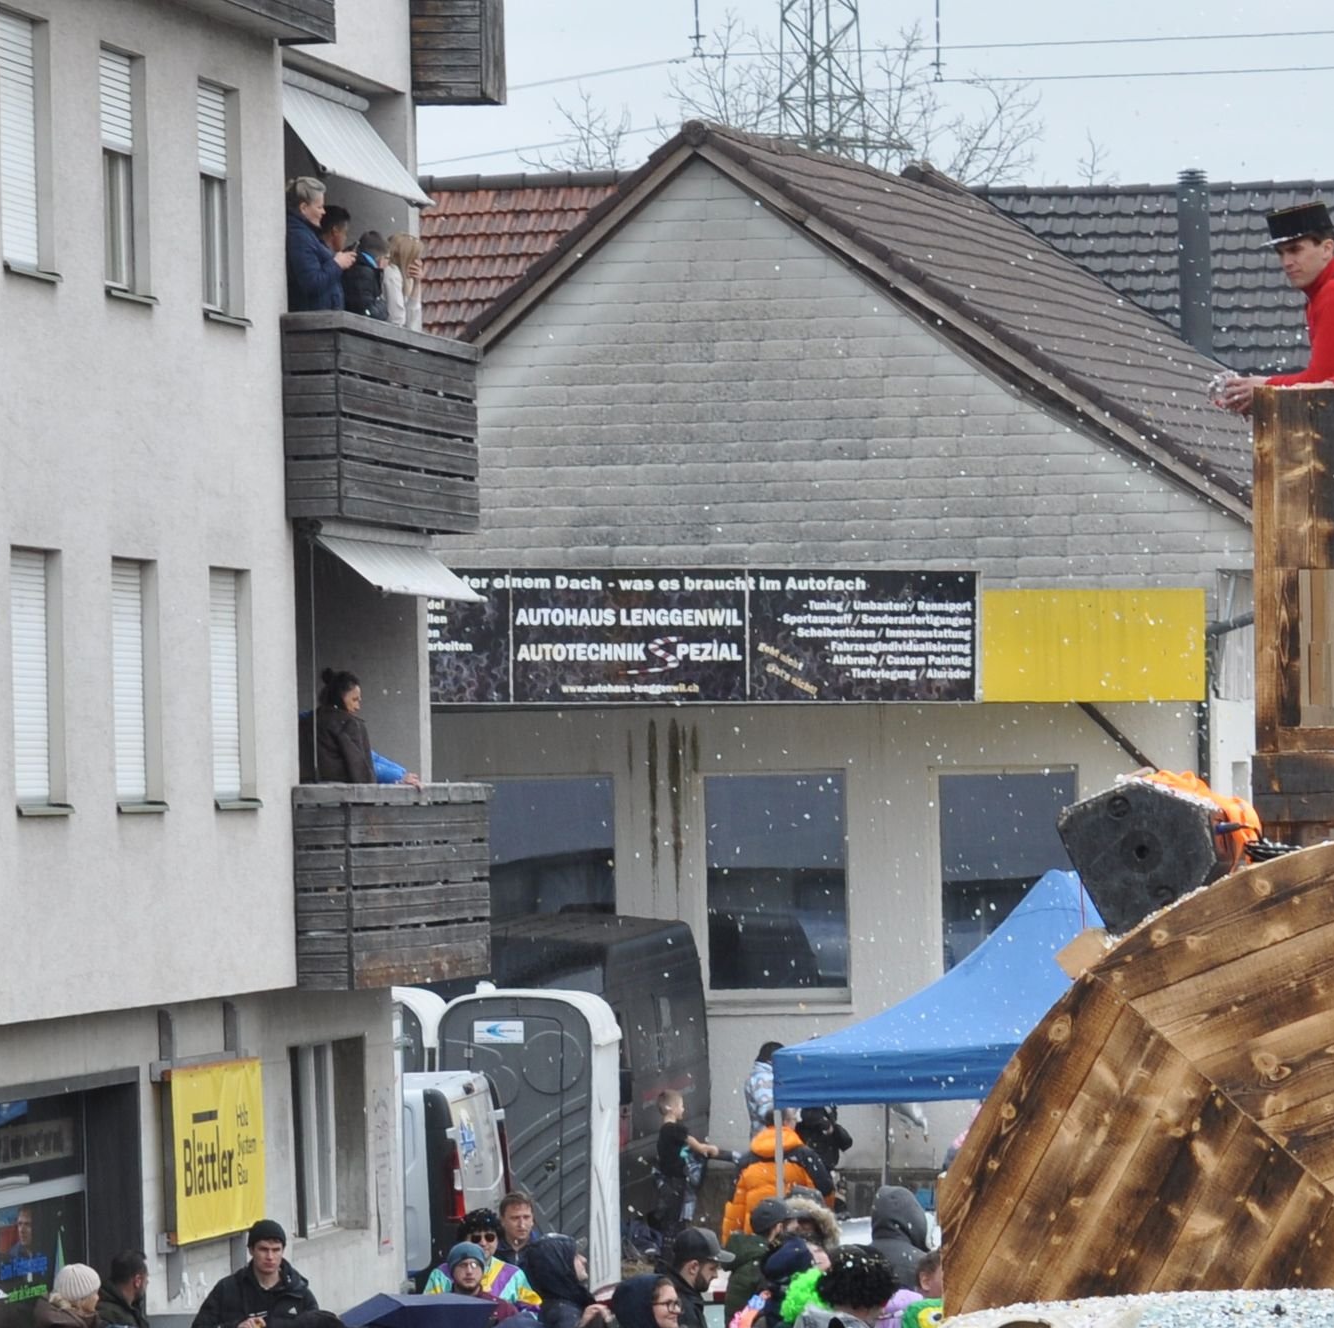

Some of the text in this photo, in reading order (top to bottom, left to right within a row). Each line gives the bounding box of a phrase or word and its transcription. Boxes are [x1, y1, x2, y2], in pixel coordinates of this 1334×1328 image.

[493, 575, 550, 590] einem
[555, 575, 603, 591] Dach
[619, 578, 654, 592] was
[659, 578, 680, 592] es
[684, 577, 756, 593] braucht
[760, 577, 781, 591] im
[785, 577, 866, 592] Autofach
[809, 600, 843, 612] Tuning
[853, 600, 907, 611] Umbauten
[917, 601, 972, 613] Rennsport
[515, 608, 743, 627] AUTOHAUS LENGGENWIL
[782, 613, 852, 626] Sportauspuff
[861, 613, 972, 627] Sonderanfertigungen
[796, 627, 876, 639] Scheibentönen
[427, 641, 473, 652] arbeiten
[517, 643, 647, 662] AUTOTECHNIK
[830, 641, 972, 654] Fahrzeugindividualisierung
[831, 655, 877, 666] Airbrush
[885, 655, 926, 666] Custom
[927, 655, 972, 668] Painting
[850, 668, 917, 681] Tieferlegung
[183, 1125, 234, 1197] Blättler
